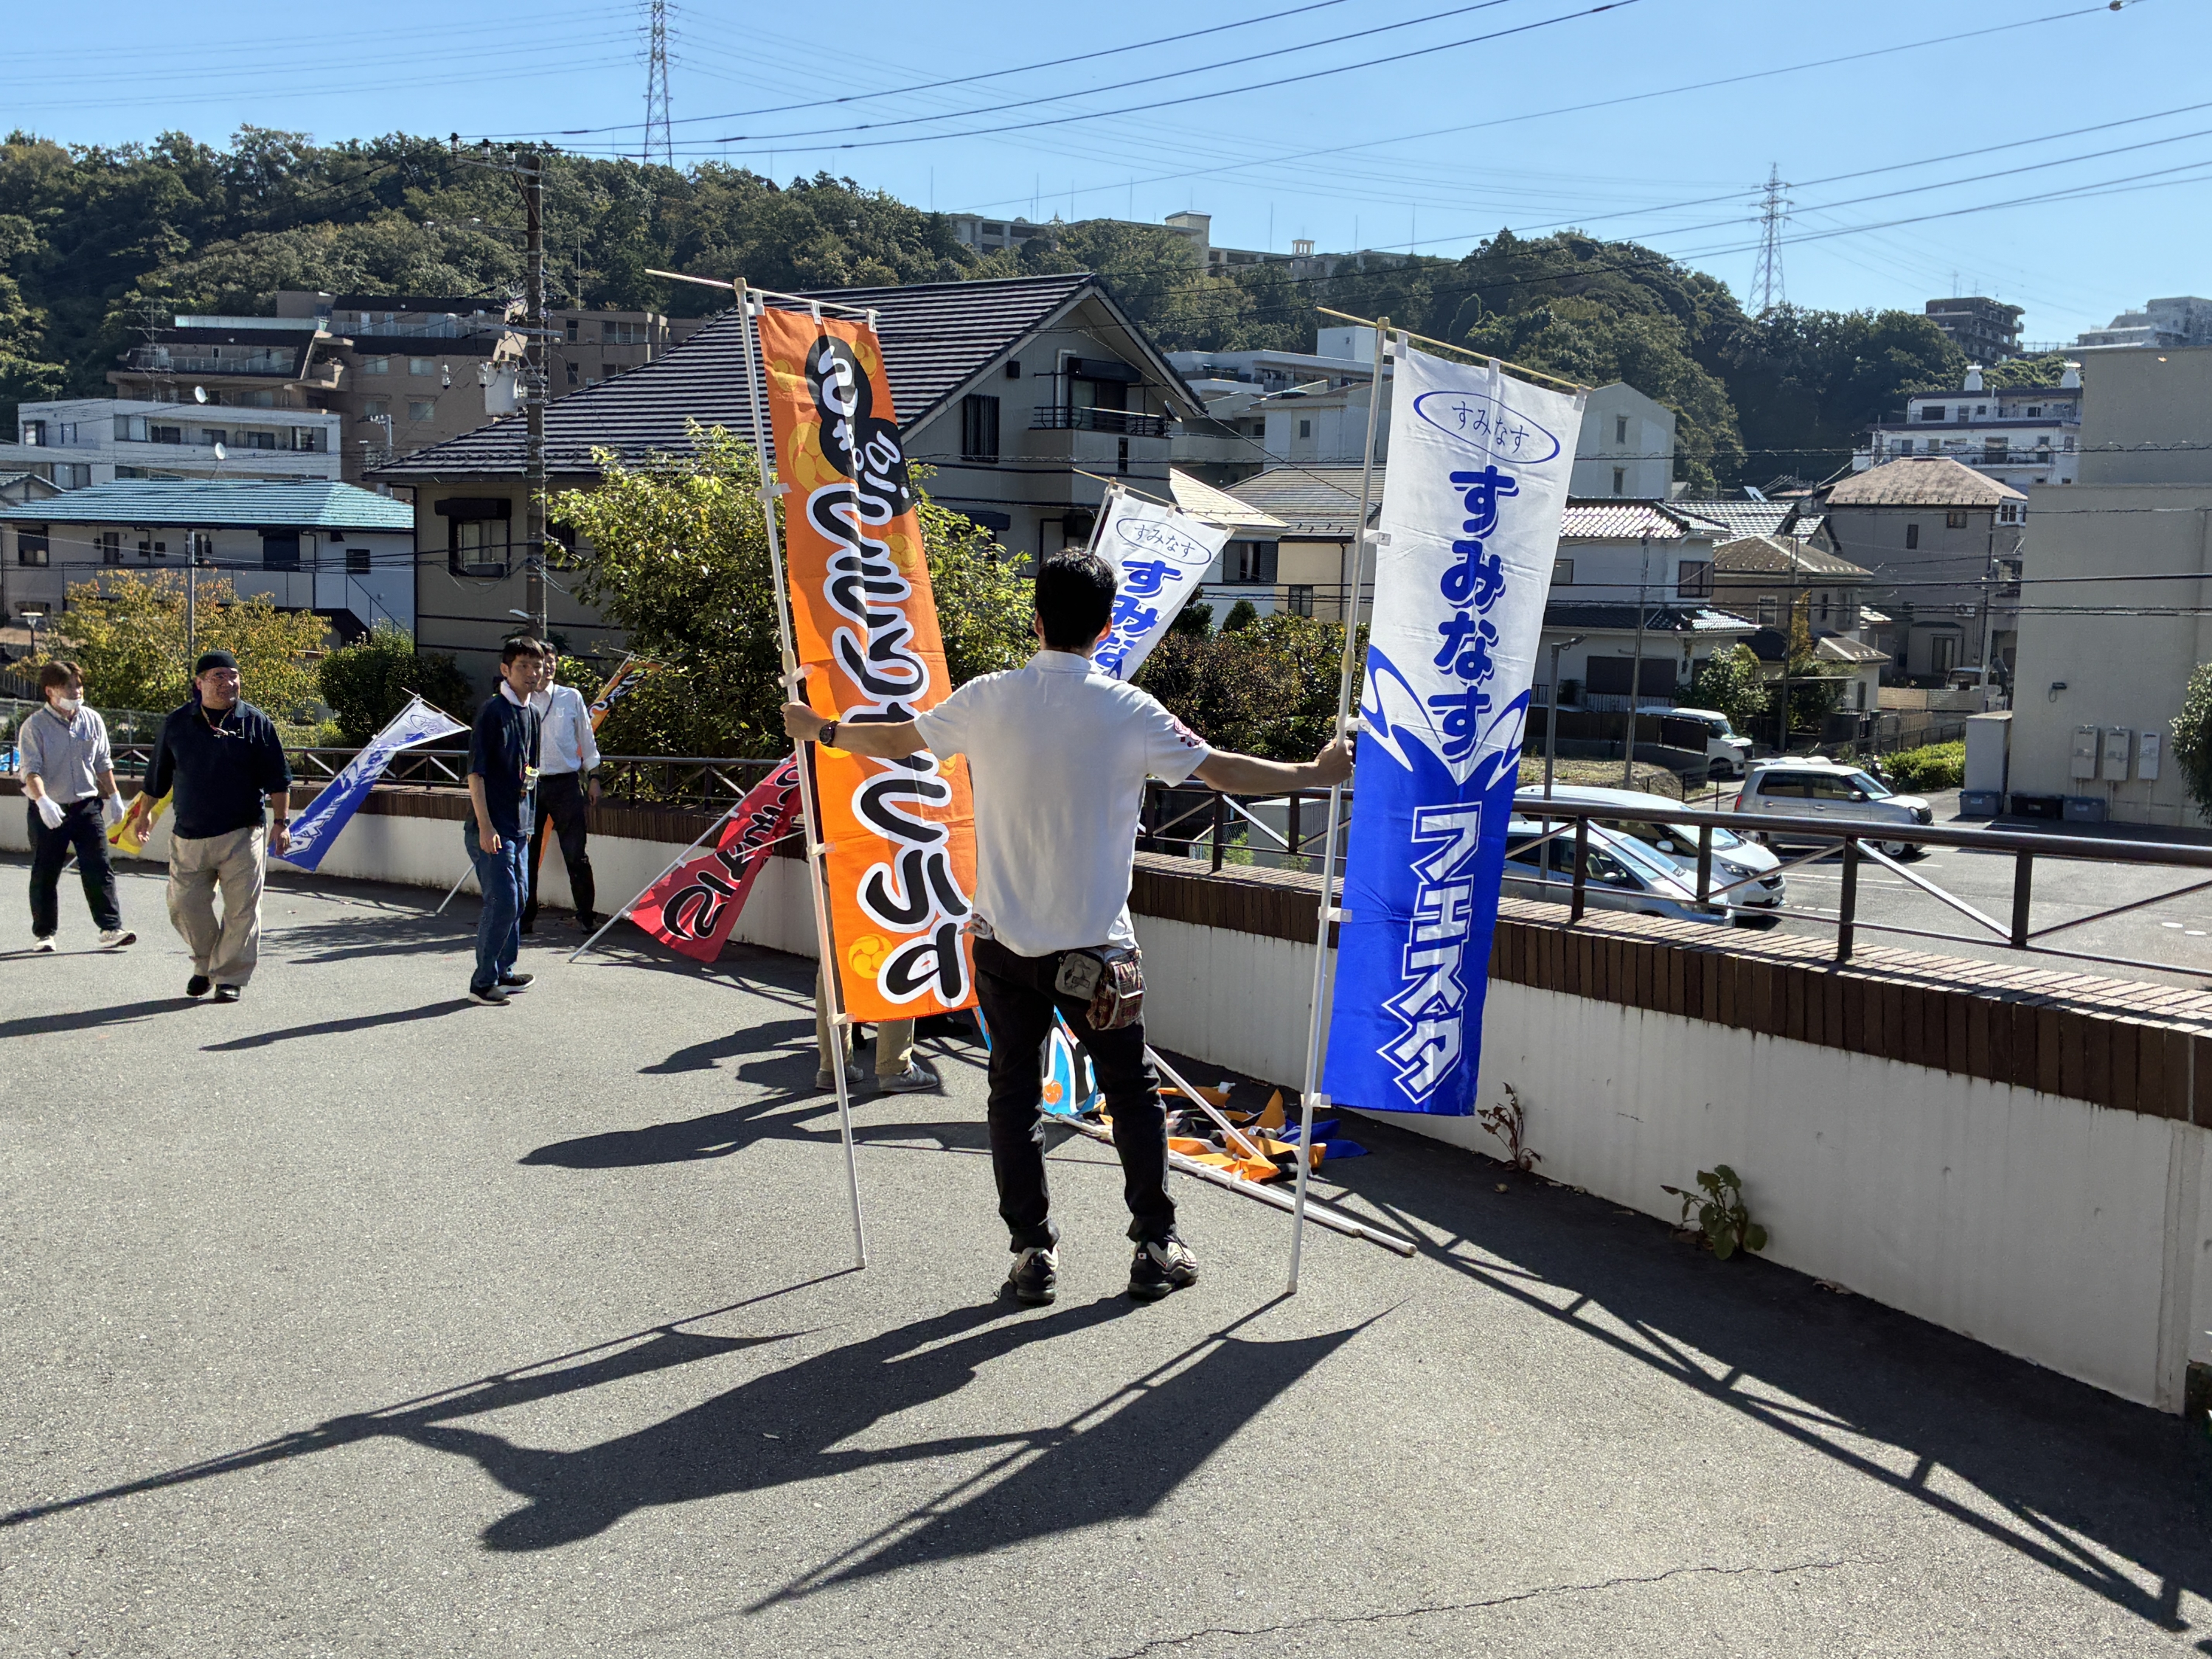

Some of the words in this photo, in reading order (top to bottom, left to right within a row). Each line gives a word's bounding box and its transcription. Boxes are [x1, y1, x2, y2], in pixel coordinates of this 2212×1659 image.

[1451, 401, 1530, 453] すみなす
[1134, 524, 1196, 558] すみなす
[1427, 465, 1520, 764] すみなす
